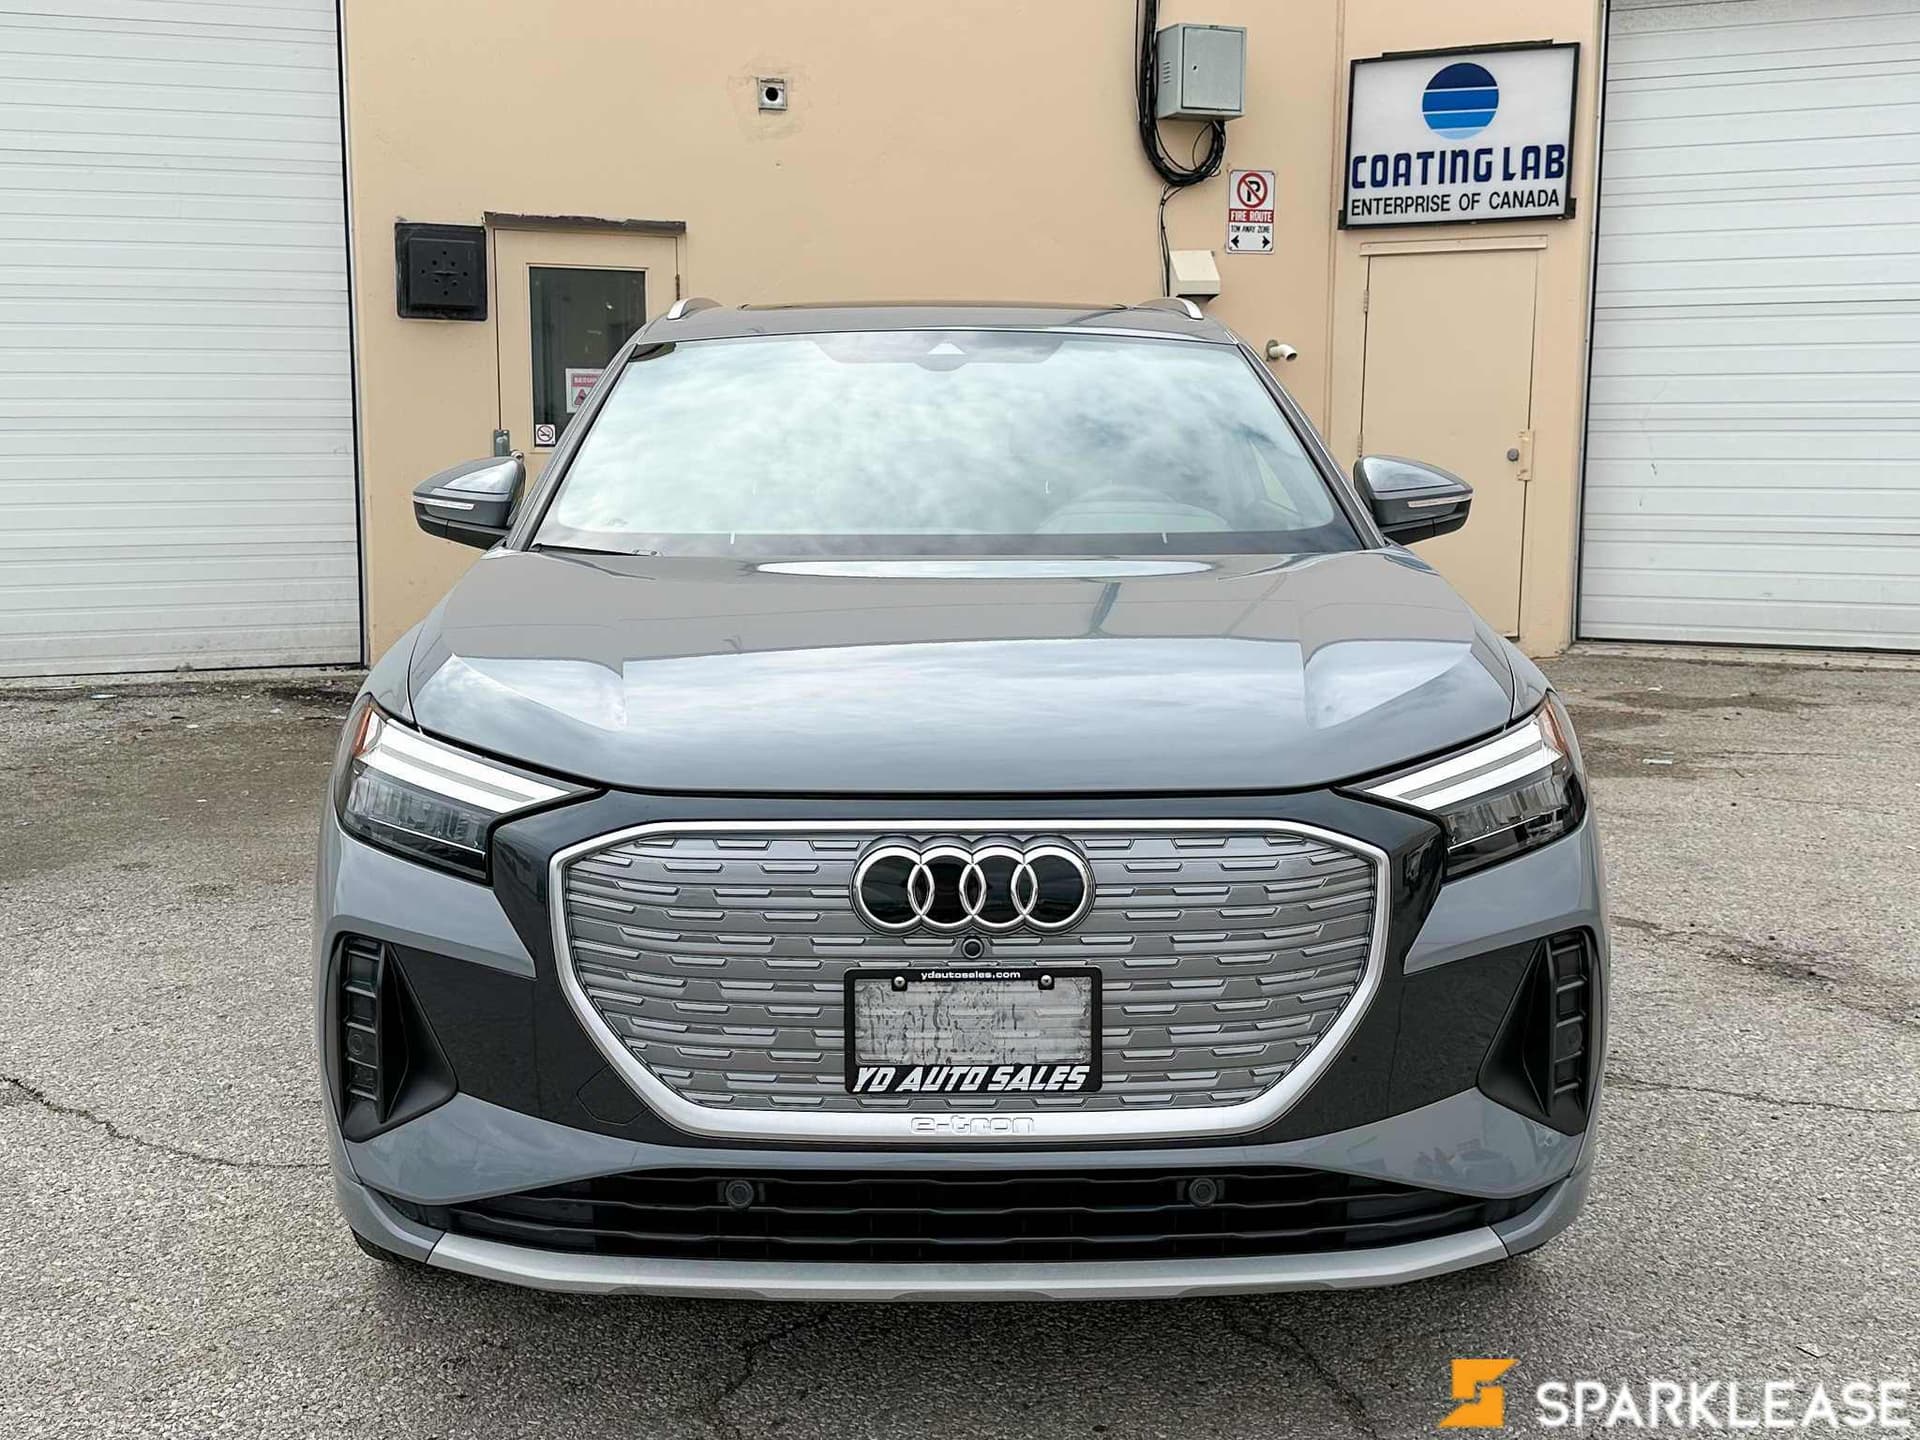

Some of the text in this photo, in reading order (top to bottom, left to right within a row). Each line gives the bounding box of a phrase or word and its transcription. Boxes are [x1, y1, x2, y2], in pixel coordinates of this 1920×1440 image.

[1502, 144, 1565, 181] LAB
[1351, 189, 1559, 216] ENTERPRISE OF CANADA
[1231, 210, 1272, 222] FIRE ROUTE
[1231, 225, 1241, 233] TOW
[921, 971, 1021, 981] ydautosales.com
[853, 1066, 1090, 1093] YD AUTO SALES
[911, 1115, 1034, 1134] e-tron
